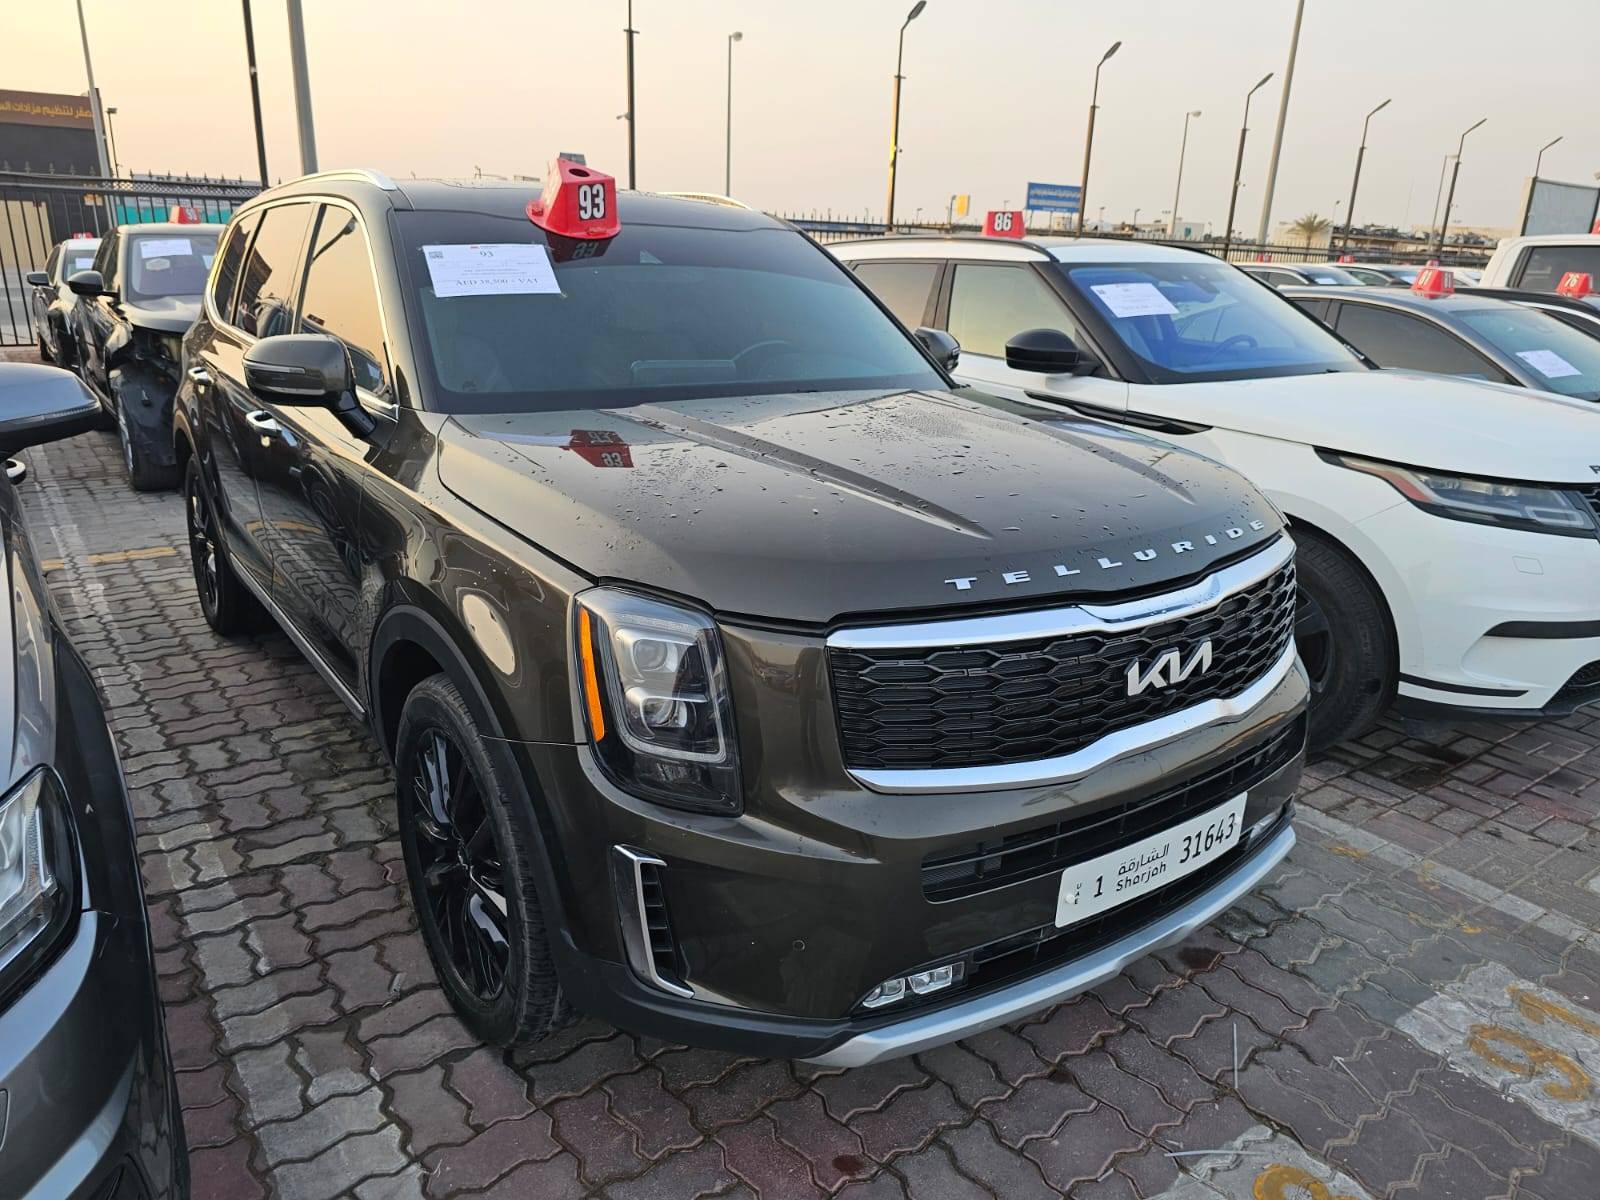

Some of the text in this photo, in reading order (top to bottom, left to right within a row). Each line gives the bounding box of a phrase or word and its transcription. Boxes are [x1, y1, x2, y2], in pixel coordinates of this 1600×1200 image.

[579, 184, 605, 220] 93
[994, 212, 1012, 231] 86
[945, 519, 1265, 591] TELLURIDE
[1179, 812, 1237, 864] 31643
[1118, 843, 1170, 876] الشارقة
[1093, 875, 1104, 898] 1
[1115, 862, 1167, 892] Sharjah
